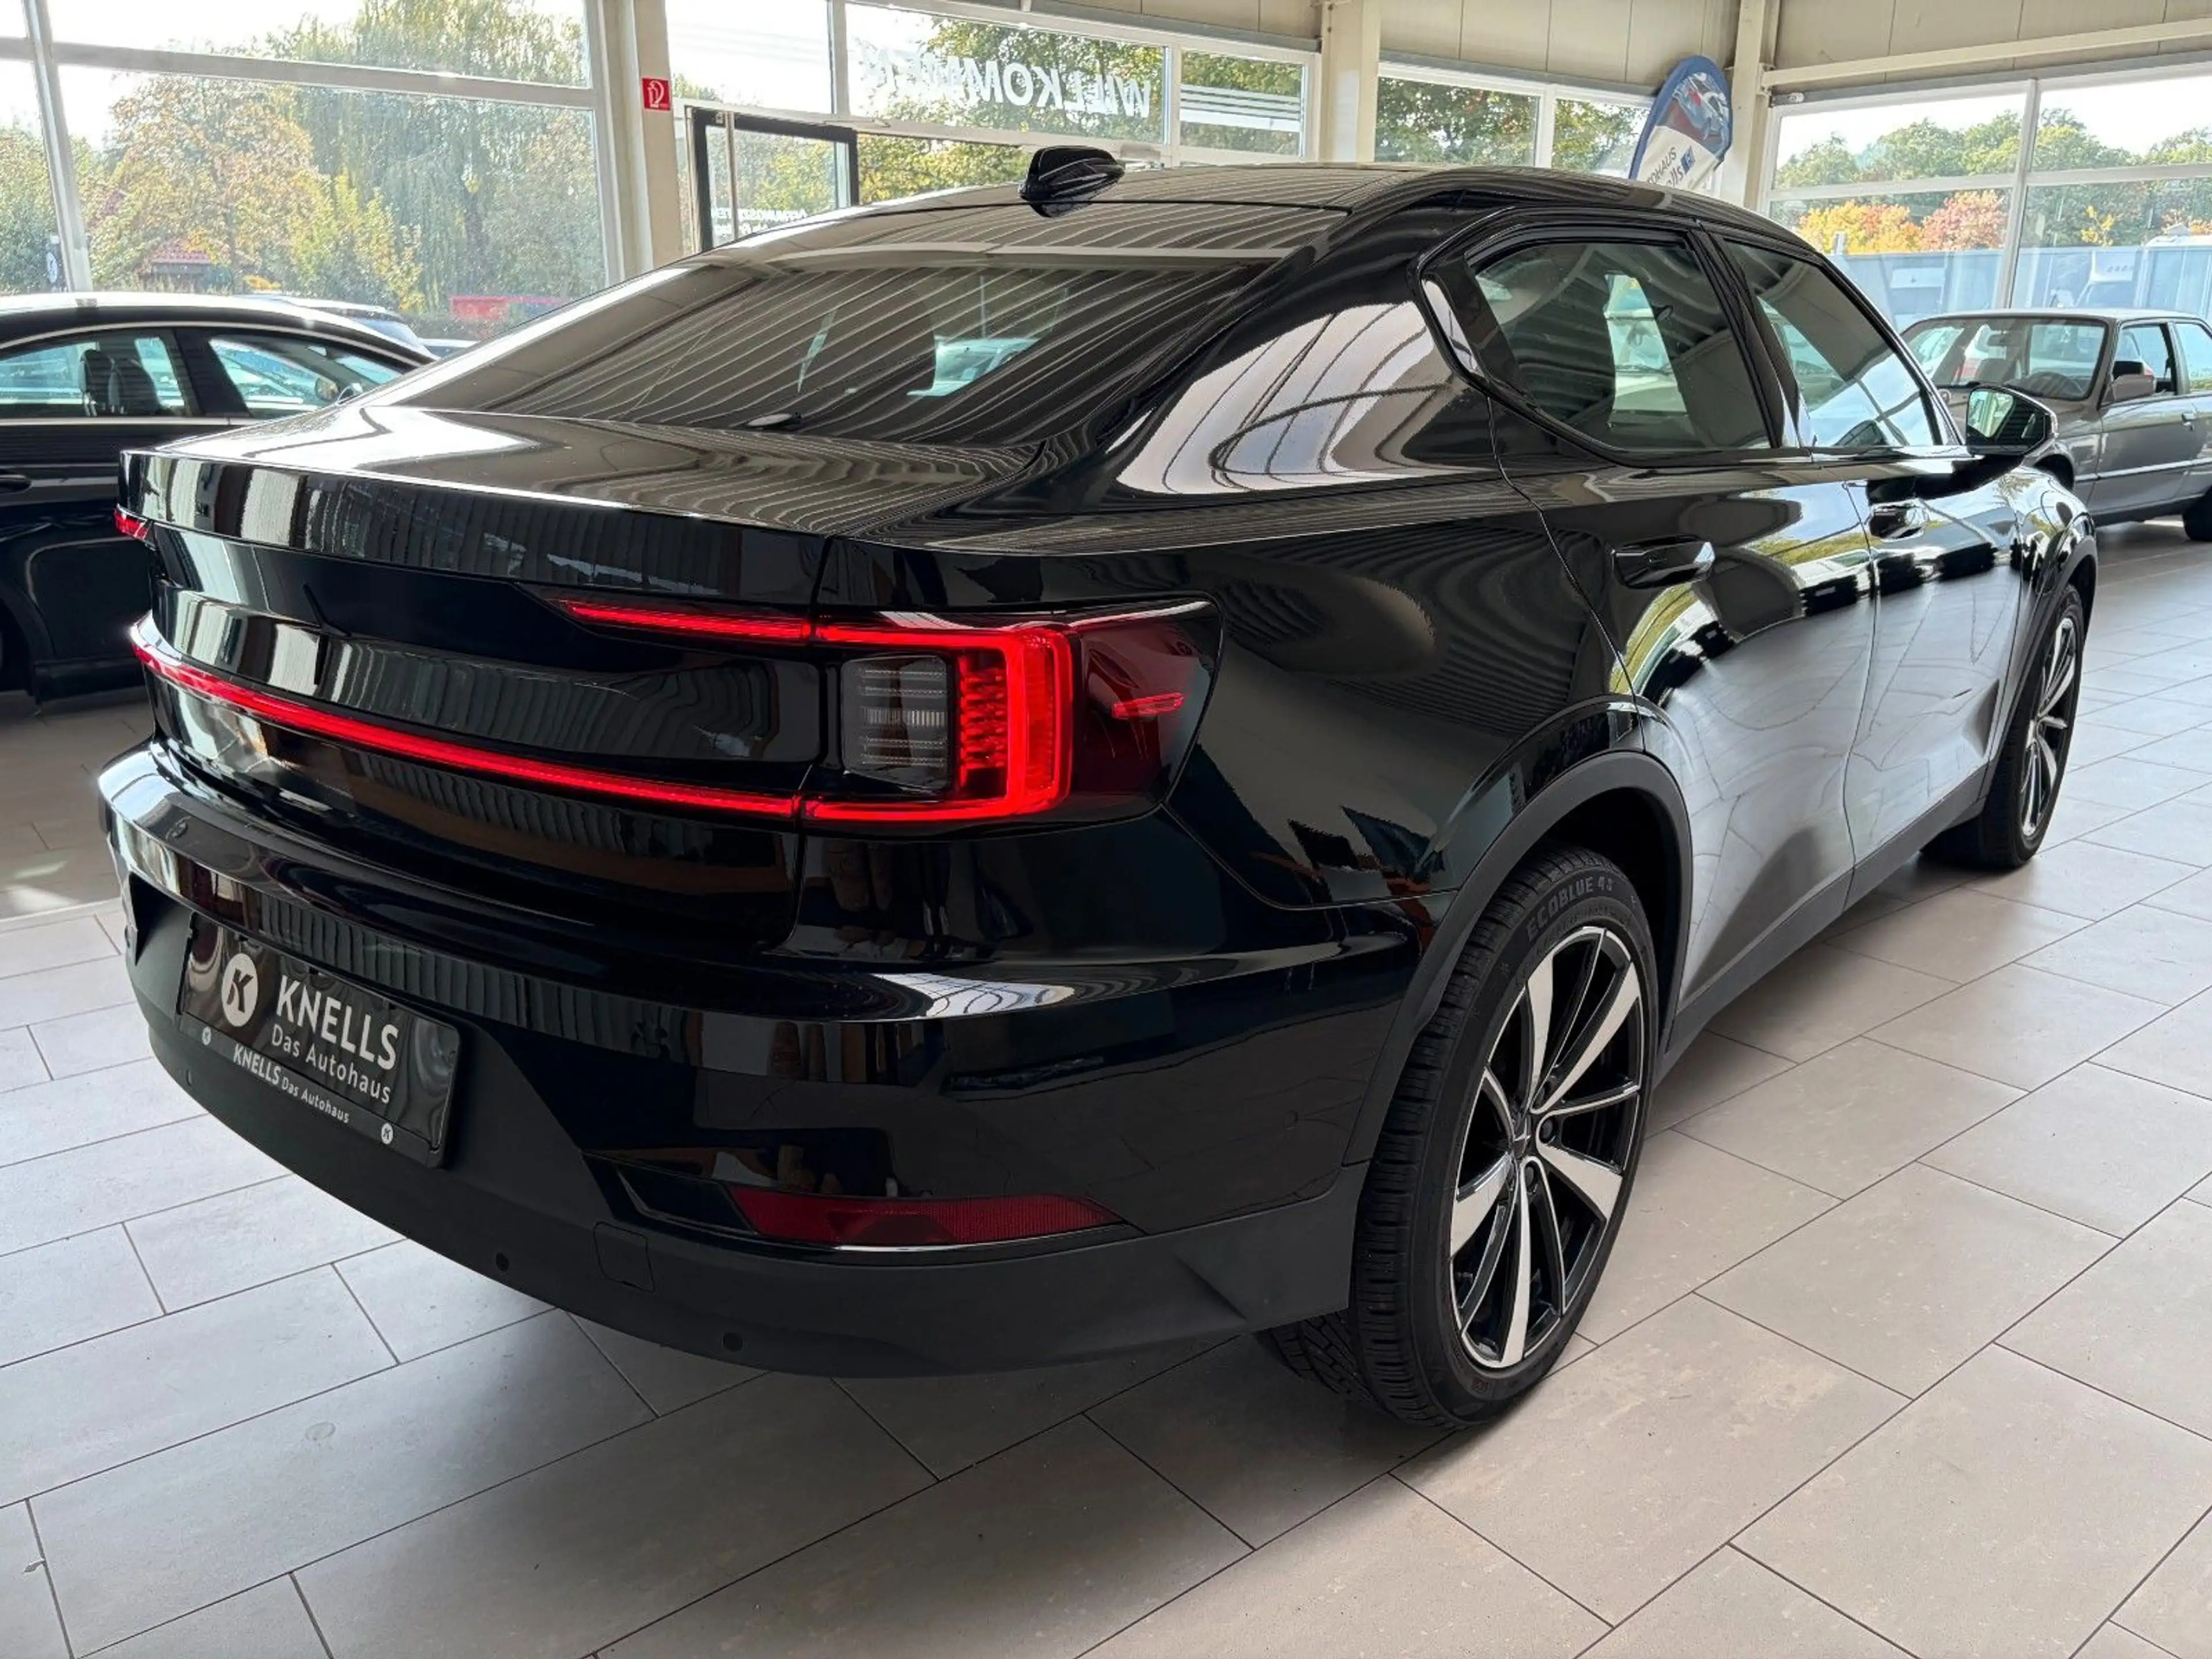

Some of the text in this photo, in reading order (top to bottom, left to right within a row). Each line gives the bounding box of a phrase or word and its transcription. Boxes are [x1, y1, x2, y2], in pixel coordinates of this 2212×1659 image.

[1526, 876, 1594, 942] ECOBLUE
[276, 975, 399, 1070] KNELLS
[232, 1043, 350, 1124] KNELLS Das Autohaus
[271, 1024, 391, 1104] Das Autohaus
